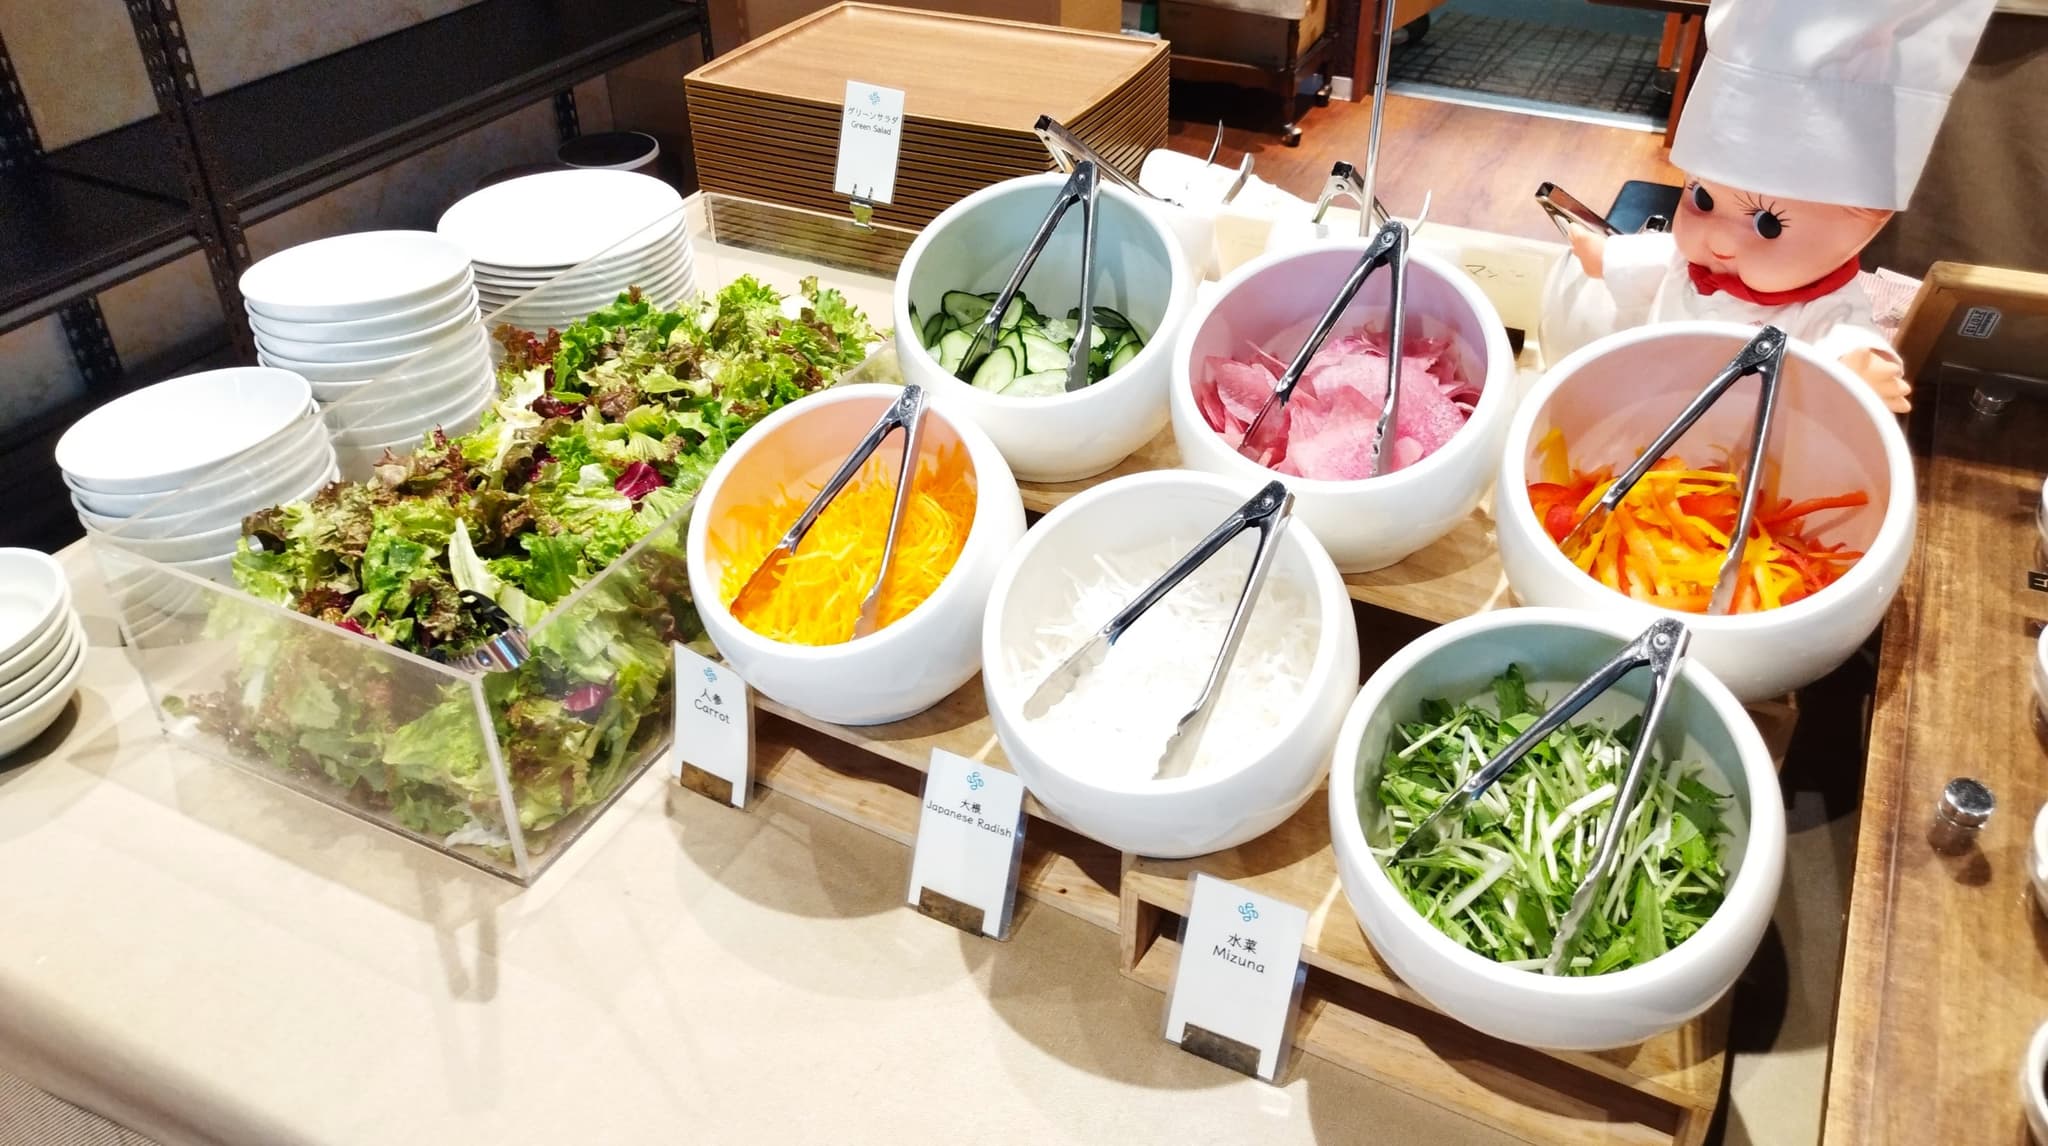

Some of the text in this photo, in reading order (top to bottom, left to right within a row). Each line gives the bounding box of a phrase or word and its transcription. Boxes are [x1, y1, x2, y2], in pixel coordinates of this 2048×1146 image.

[851, 120, 891, 136] Green Salad
[694, 698, 730, 724] Carrot
[926, 800, 1012, 838] Japanese Radish
[960, 800, 982, 815] 大根
[1227, 933, 1258, 955] 水菜
[1212, 944, 1265, 974] Mizuna
